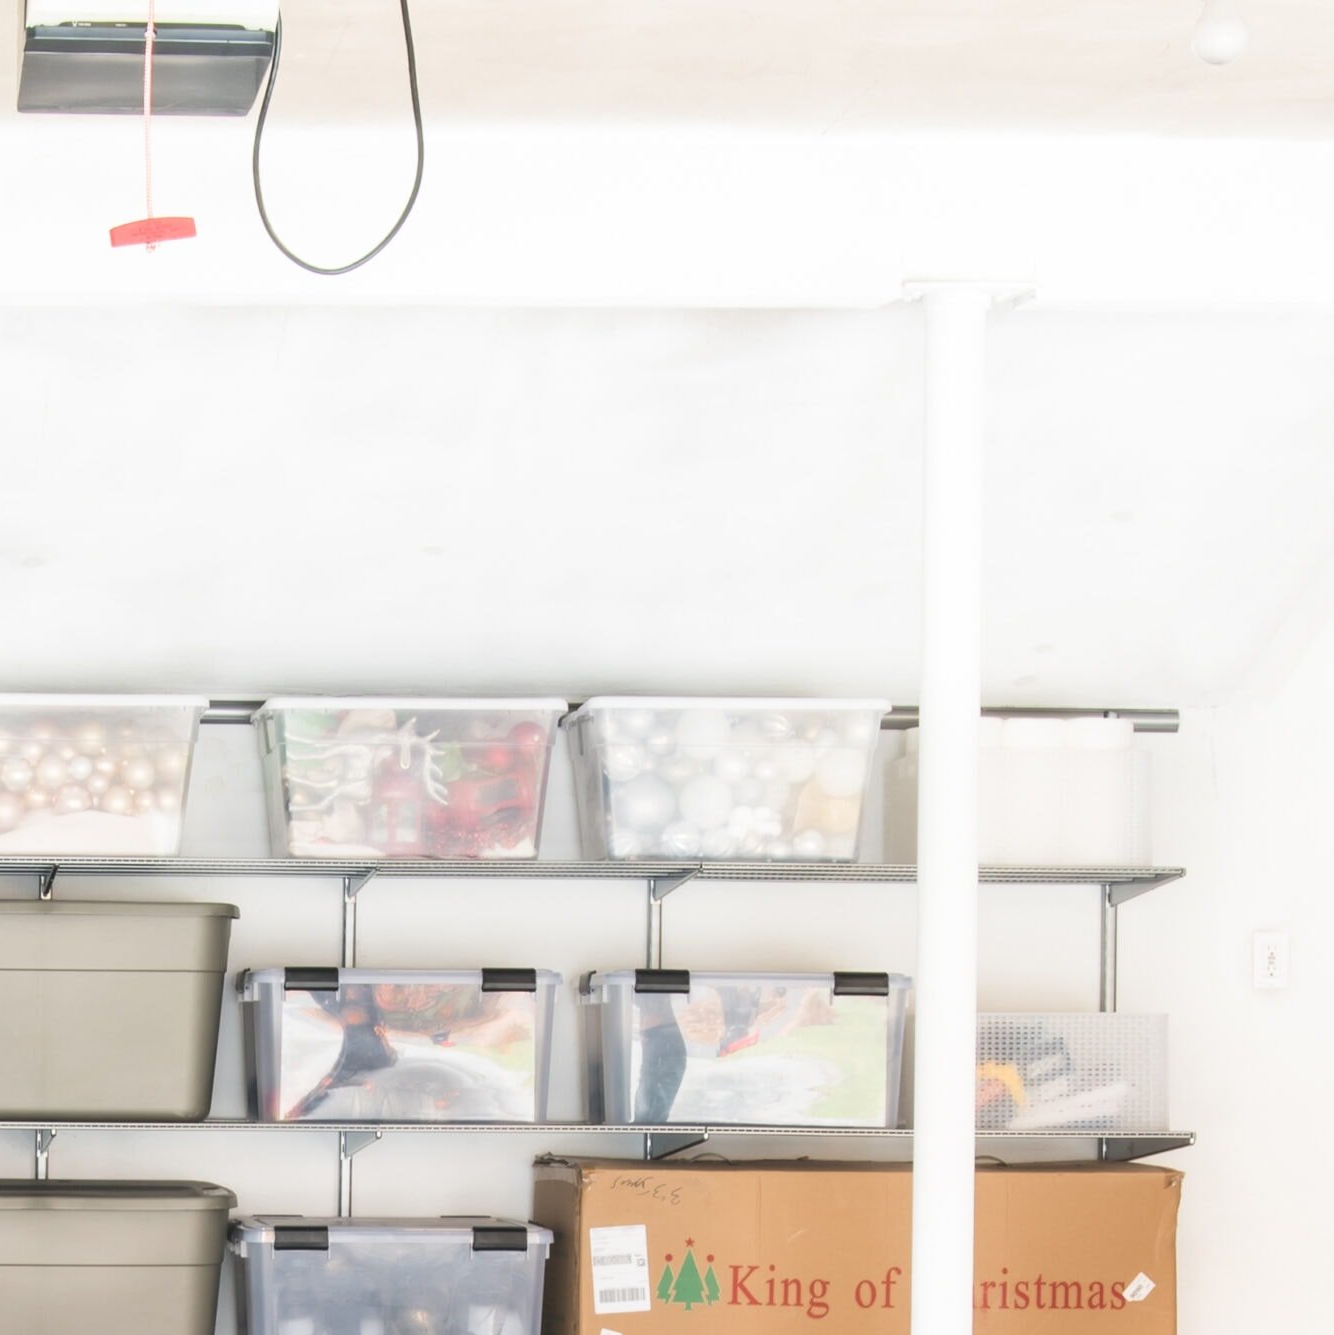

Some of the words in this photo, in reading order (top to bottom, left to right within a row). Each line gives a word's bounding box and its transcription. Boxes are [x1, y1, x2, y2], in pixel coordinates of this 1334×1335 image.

[727, 1264, 830, 1319] King
[854, 1266, 902, 1309] of
[972, 1267, 1127, 1310] ristmas
